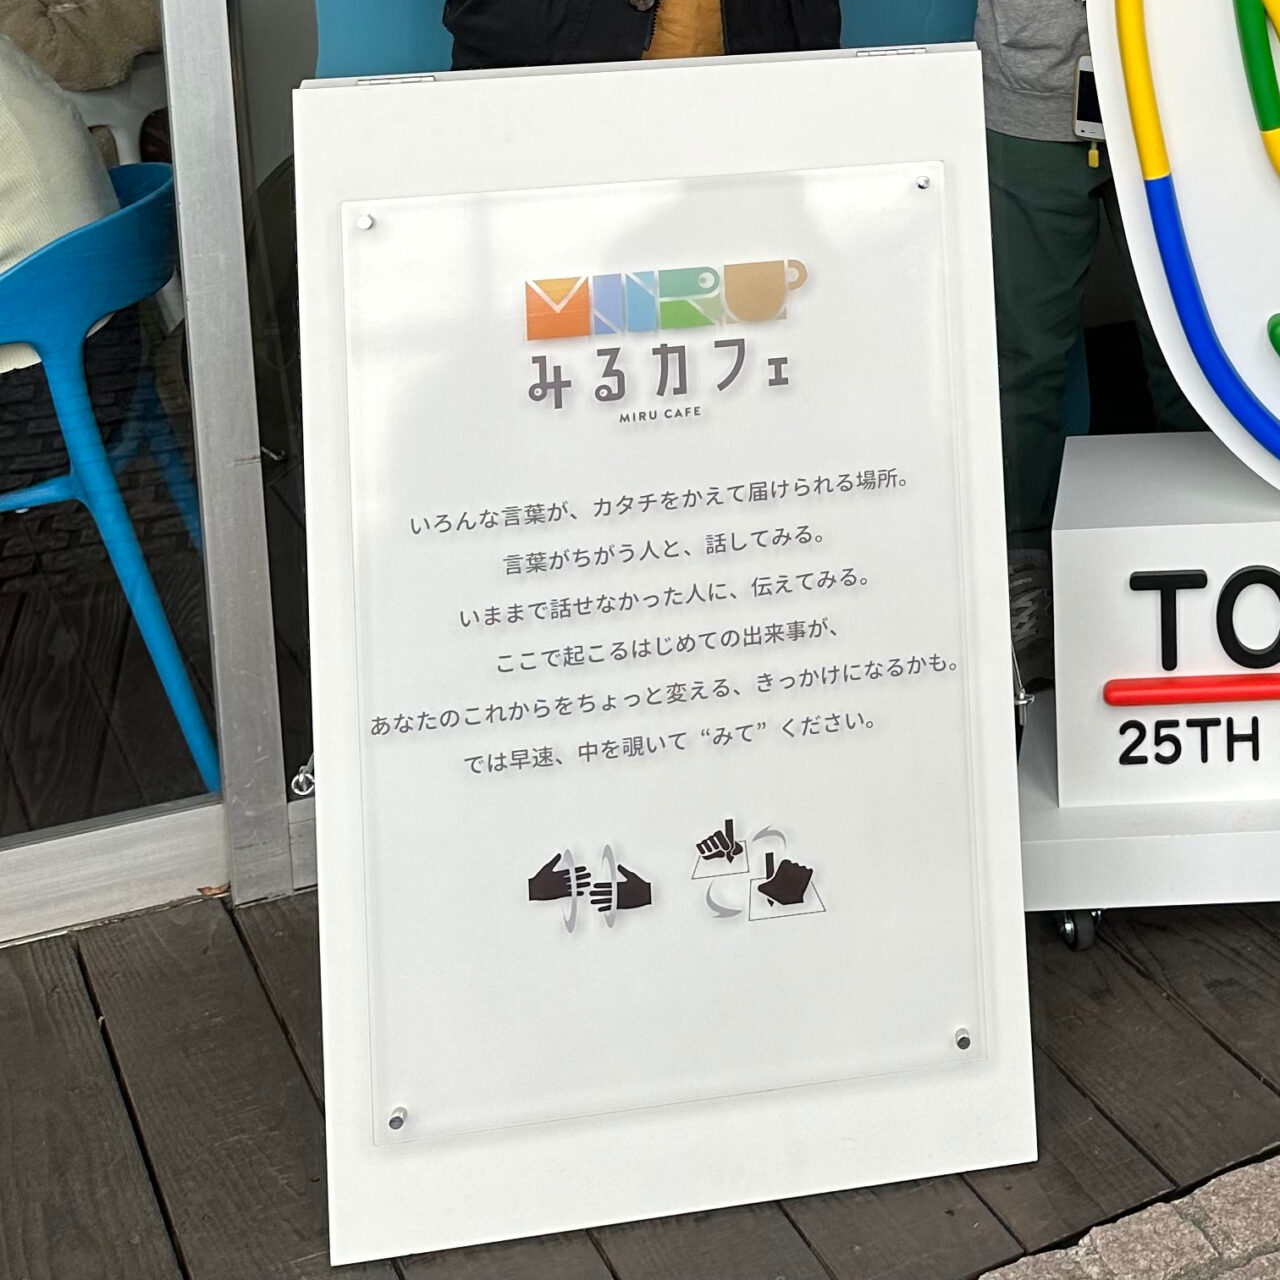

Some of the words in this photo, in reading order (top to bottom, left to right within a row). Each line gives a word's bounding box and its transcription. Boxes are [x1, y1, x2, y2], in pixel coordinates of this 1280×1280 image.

[528, 337, 790, 410] みるカフェ
[618, 409, 658, 424] MIRU
[663, 405, 702, 420] CAFE
[410, 467, 907, 535] いろんな言葉が、カタチをかえて届けられる場所。
[502, 524, 823, 576] 言葉がちがう人と、話してみる。
[459, 568, 869, 628] いままで話せなかった人に、伝えてみる。
[497, 617, 838, 673] ここで起こるはじめての出来事が、
[370, 652, 957, 736] あなたのこれからをちょっと変える、きっかけになるかも。
[1118, 716, 1260, 765] 25TH
